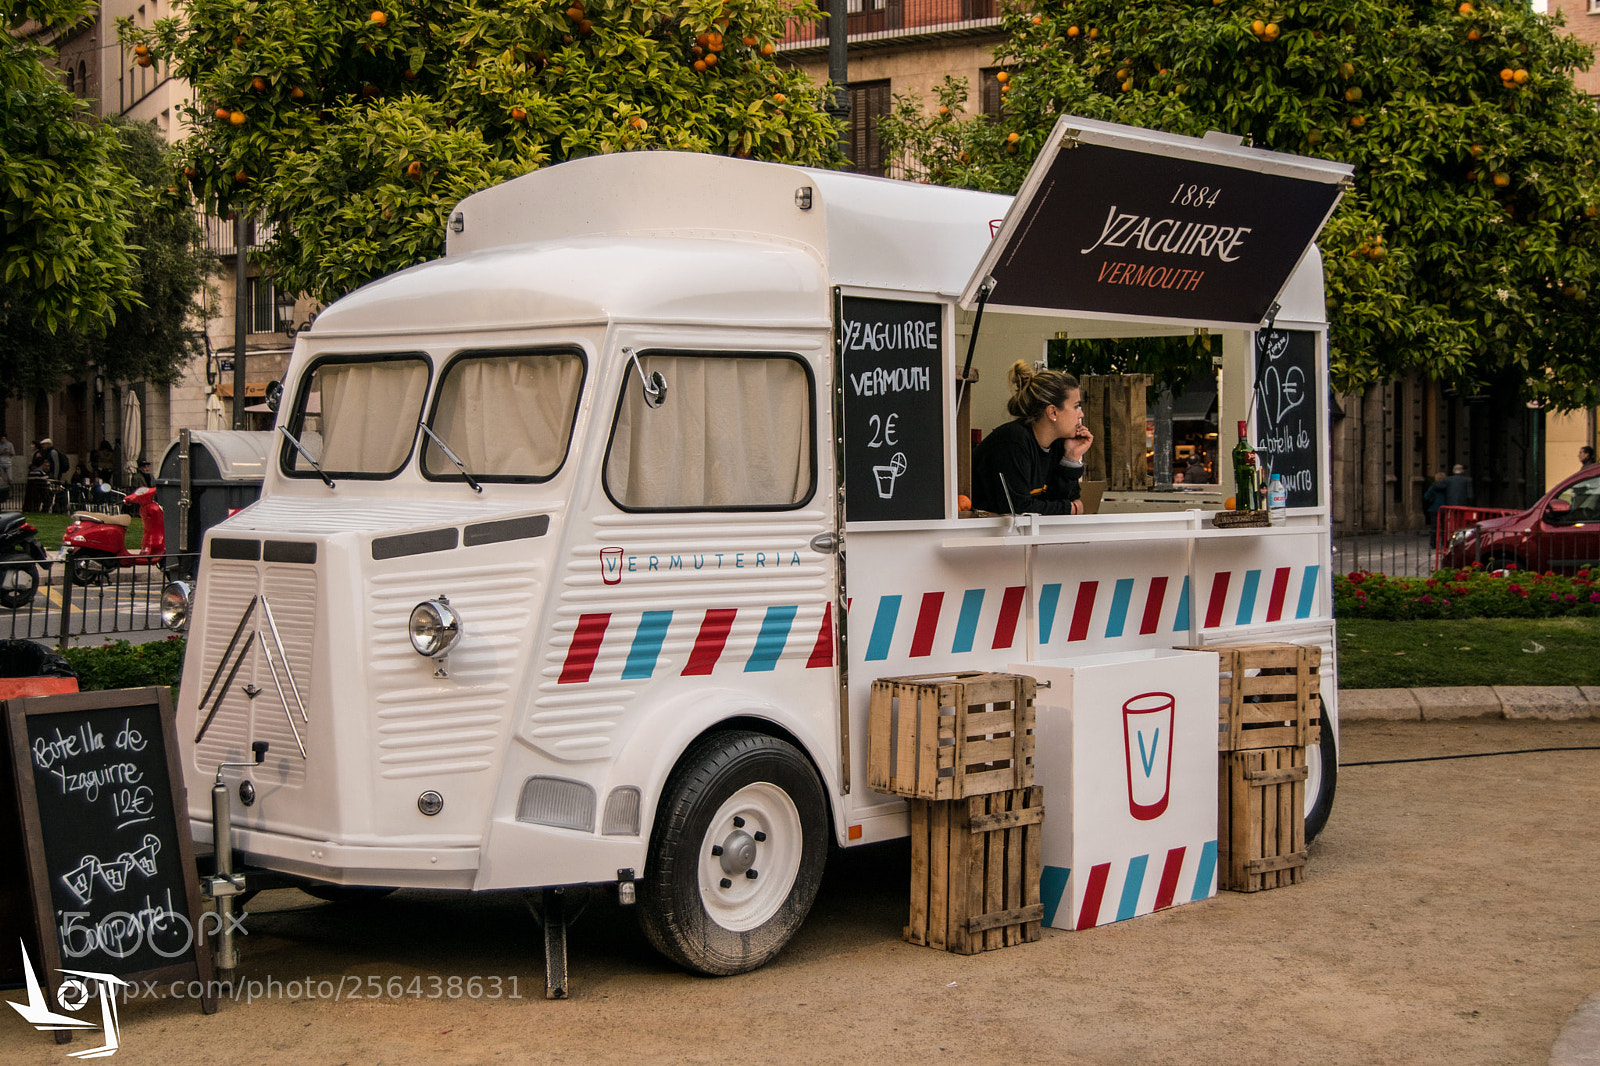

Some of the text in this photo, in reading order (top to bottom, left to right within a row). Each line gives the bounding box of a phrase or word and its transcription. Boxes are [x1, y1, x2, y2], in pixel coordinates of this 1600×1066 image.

[1170, 183, 1222, 209] 1884
[1080, 205, 1252, 263] YZAGUIRRE
[1097, 261, 1205, 291] VERMOUTH
[842, 320, 938, 354] YZAGUIRRE
[850, 366, 930, 396] VERMOUTH
[867, 412, 899, 448] 2€
[1297, 419, 1310, 449] de
[605, 551, 801, 573] VERMUTERIA
[33, 718, 148, 769] Botella de
[1137, 727, 1159, 778] V
[51, 762, 144, 802] Yzaguirre
[112, 785, 154, 817] 12€
